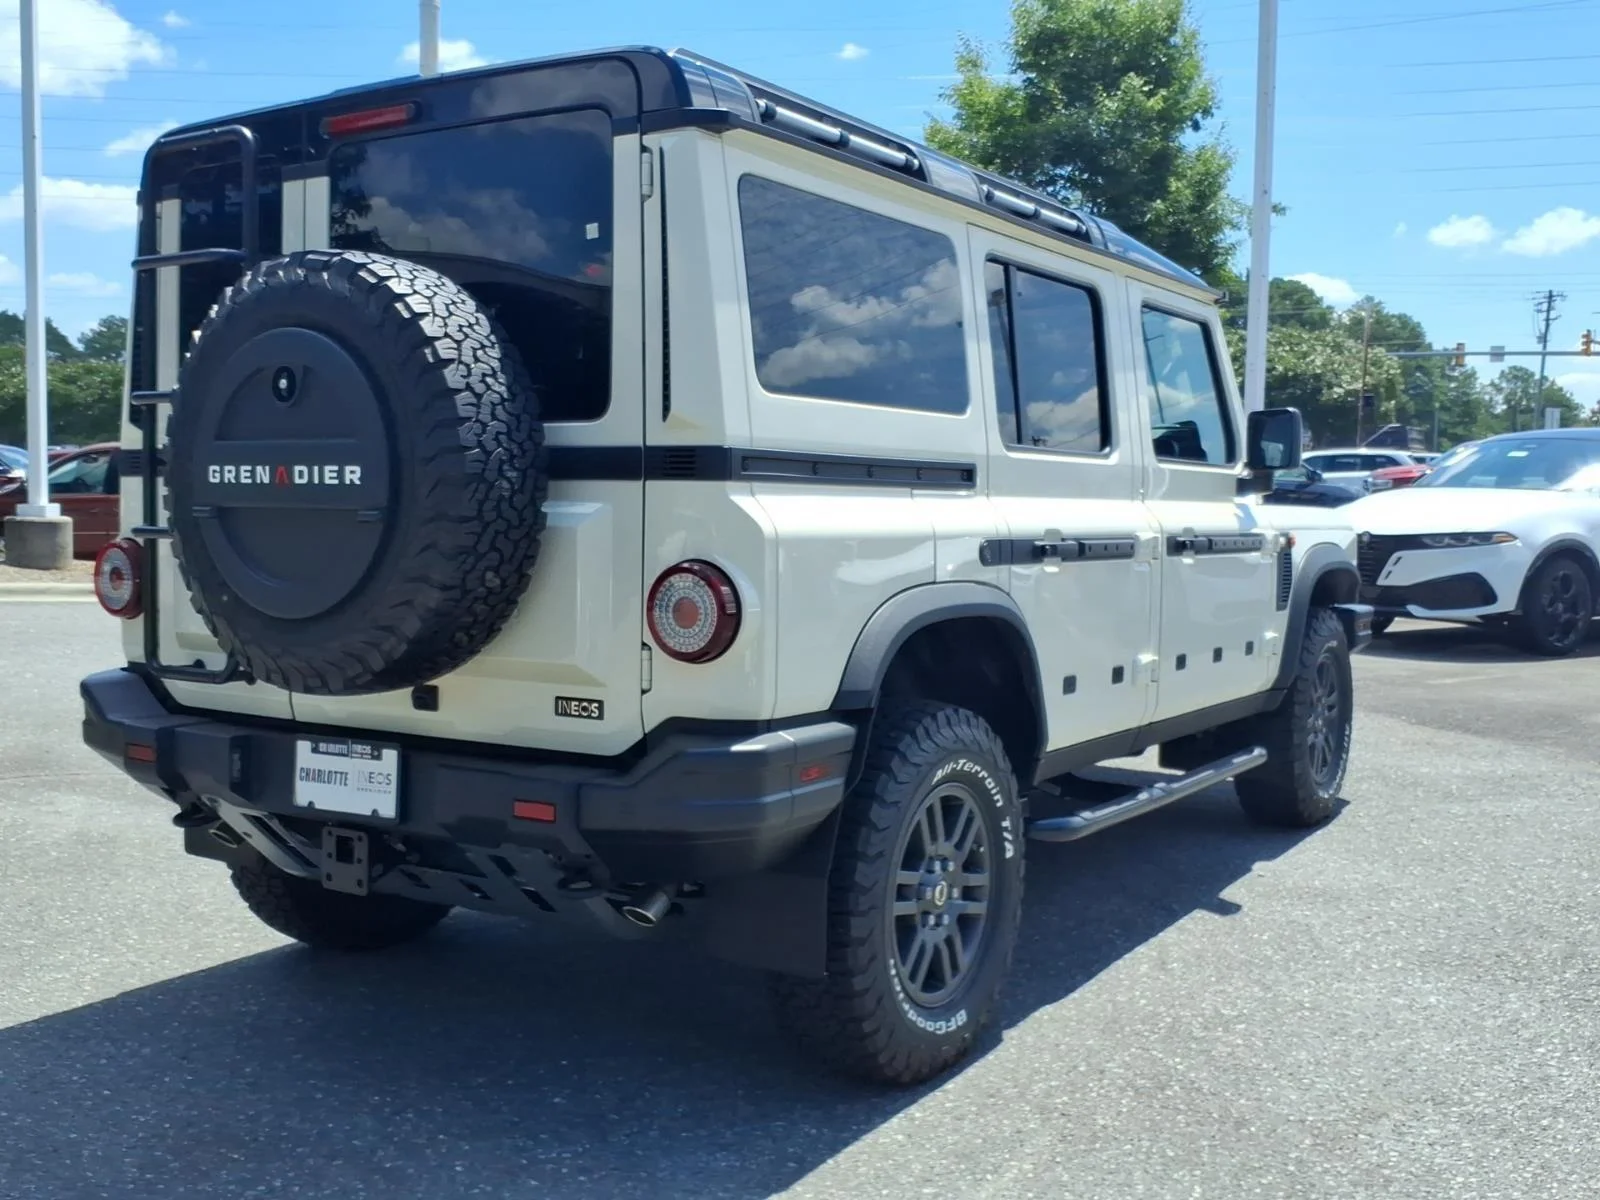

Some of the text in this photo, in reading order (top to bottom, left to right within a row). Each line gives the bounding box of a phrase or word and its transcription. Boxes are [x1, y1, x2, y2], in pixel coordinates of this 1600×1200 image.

[208, 465, 362, 485] GRENADIER
[558, 700, 599, 717] INEOS
[299, 767, 393, 786] CHARLOTTE INEOS
[931, 758, 1015, 859] All-Terrain T/A
